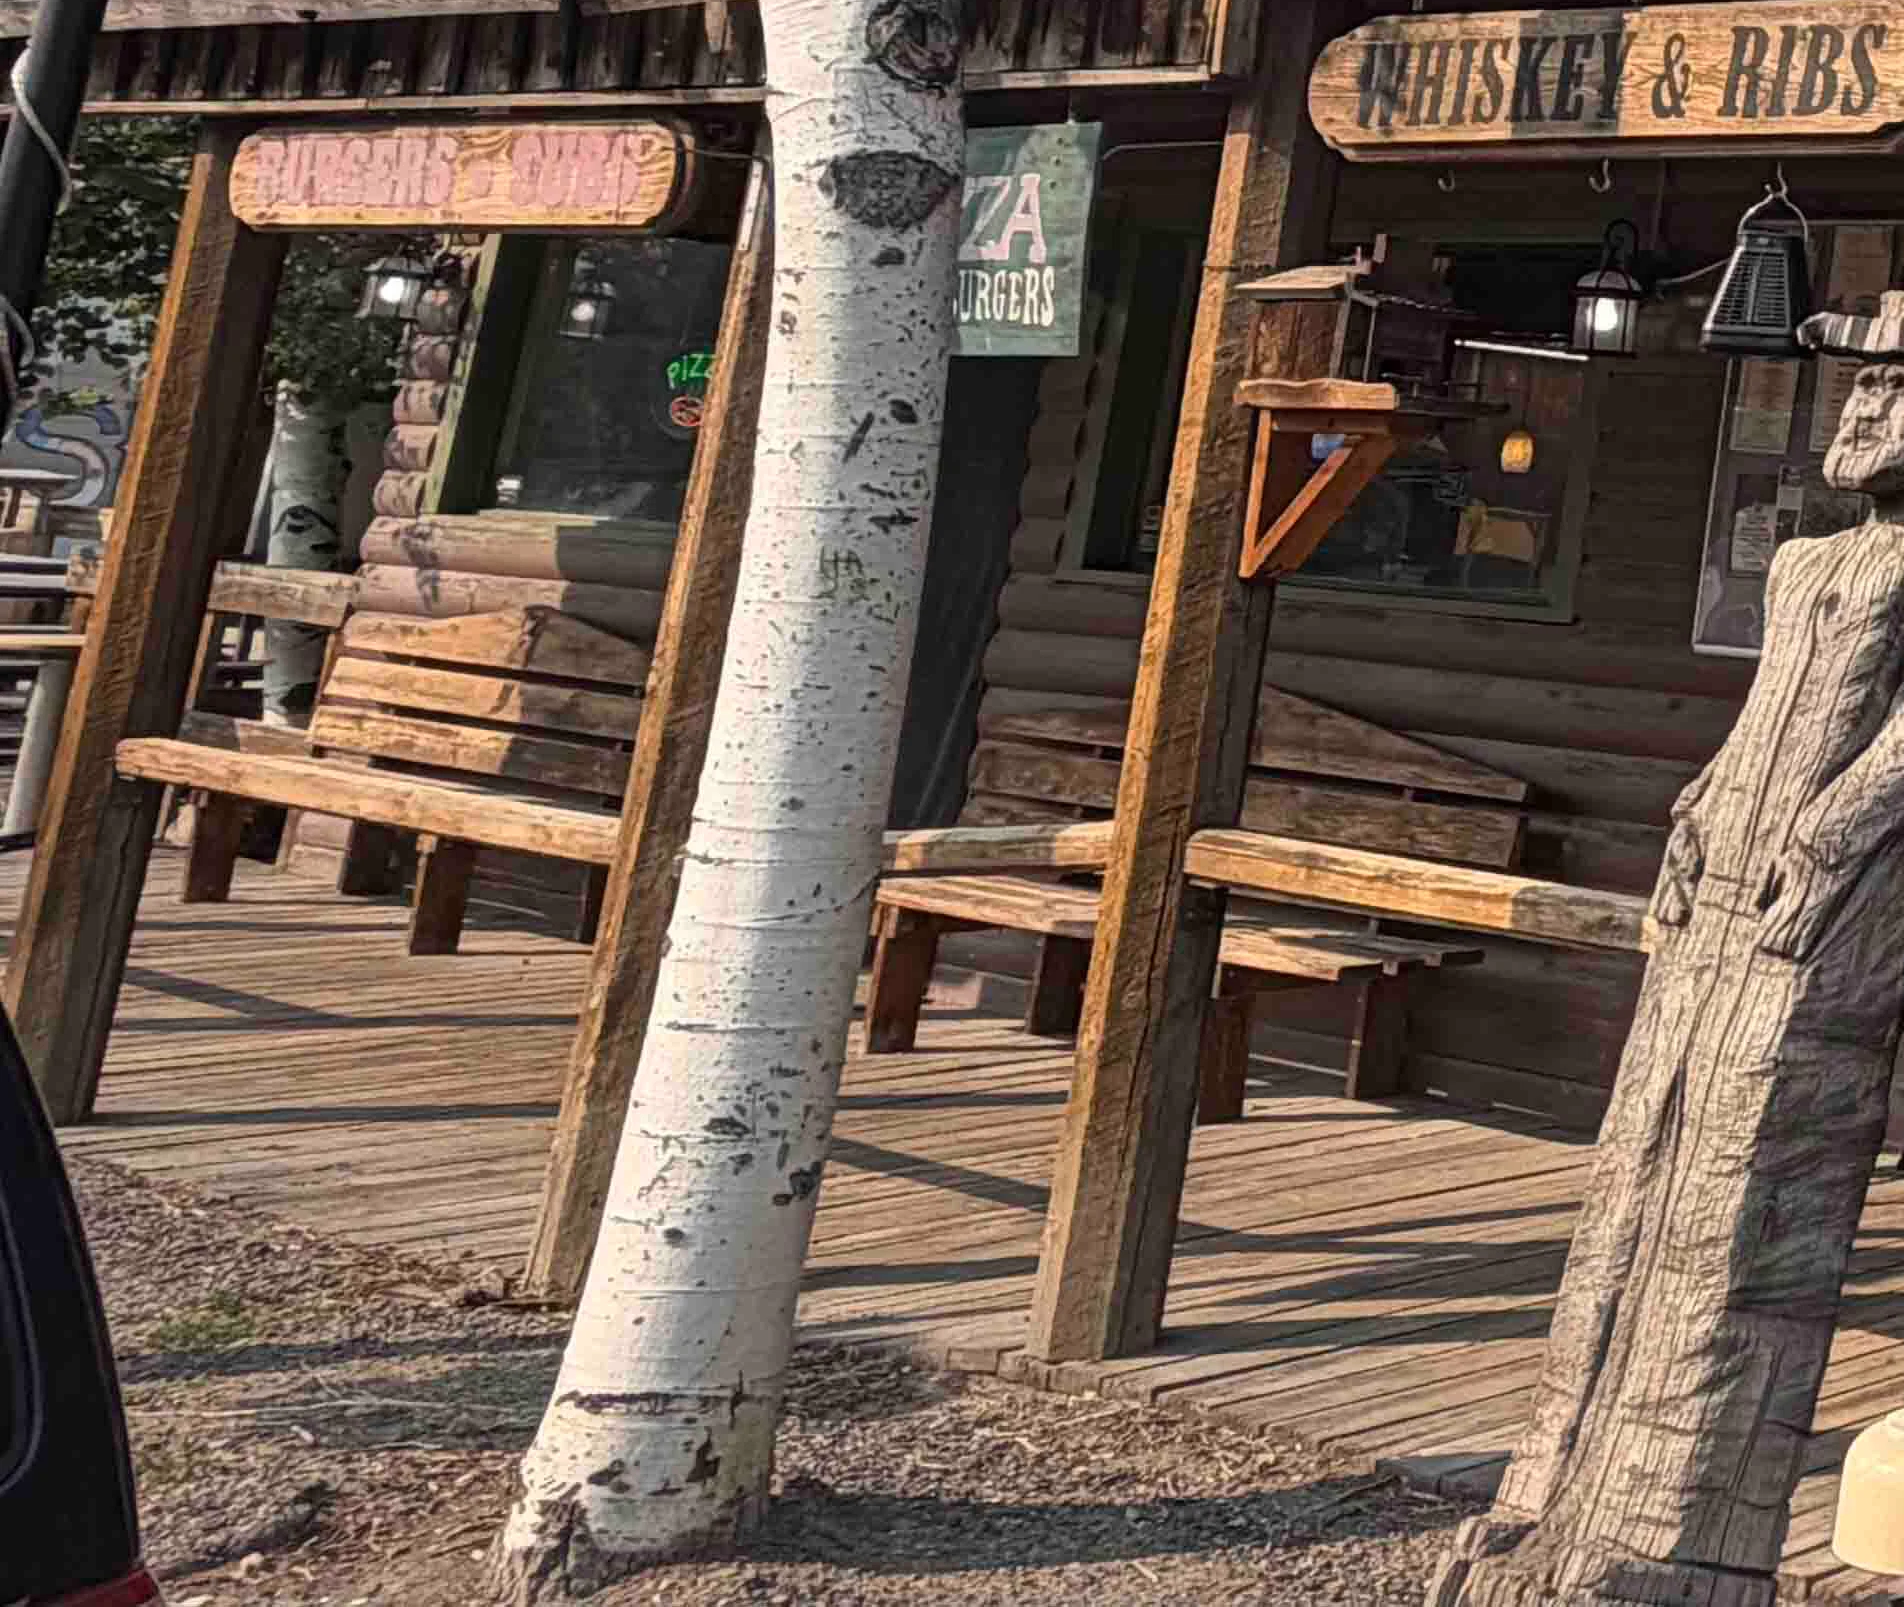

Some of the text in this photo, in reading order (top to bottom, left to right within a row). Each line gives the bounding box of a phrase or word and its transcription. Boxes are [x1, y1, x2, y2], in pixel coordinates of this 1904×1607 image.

[1355, 22, 1890, 130] WHISKEY & RIBS
[953, 266, 1056, 327] URGERS
